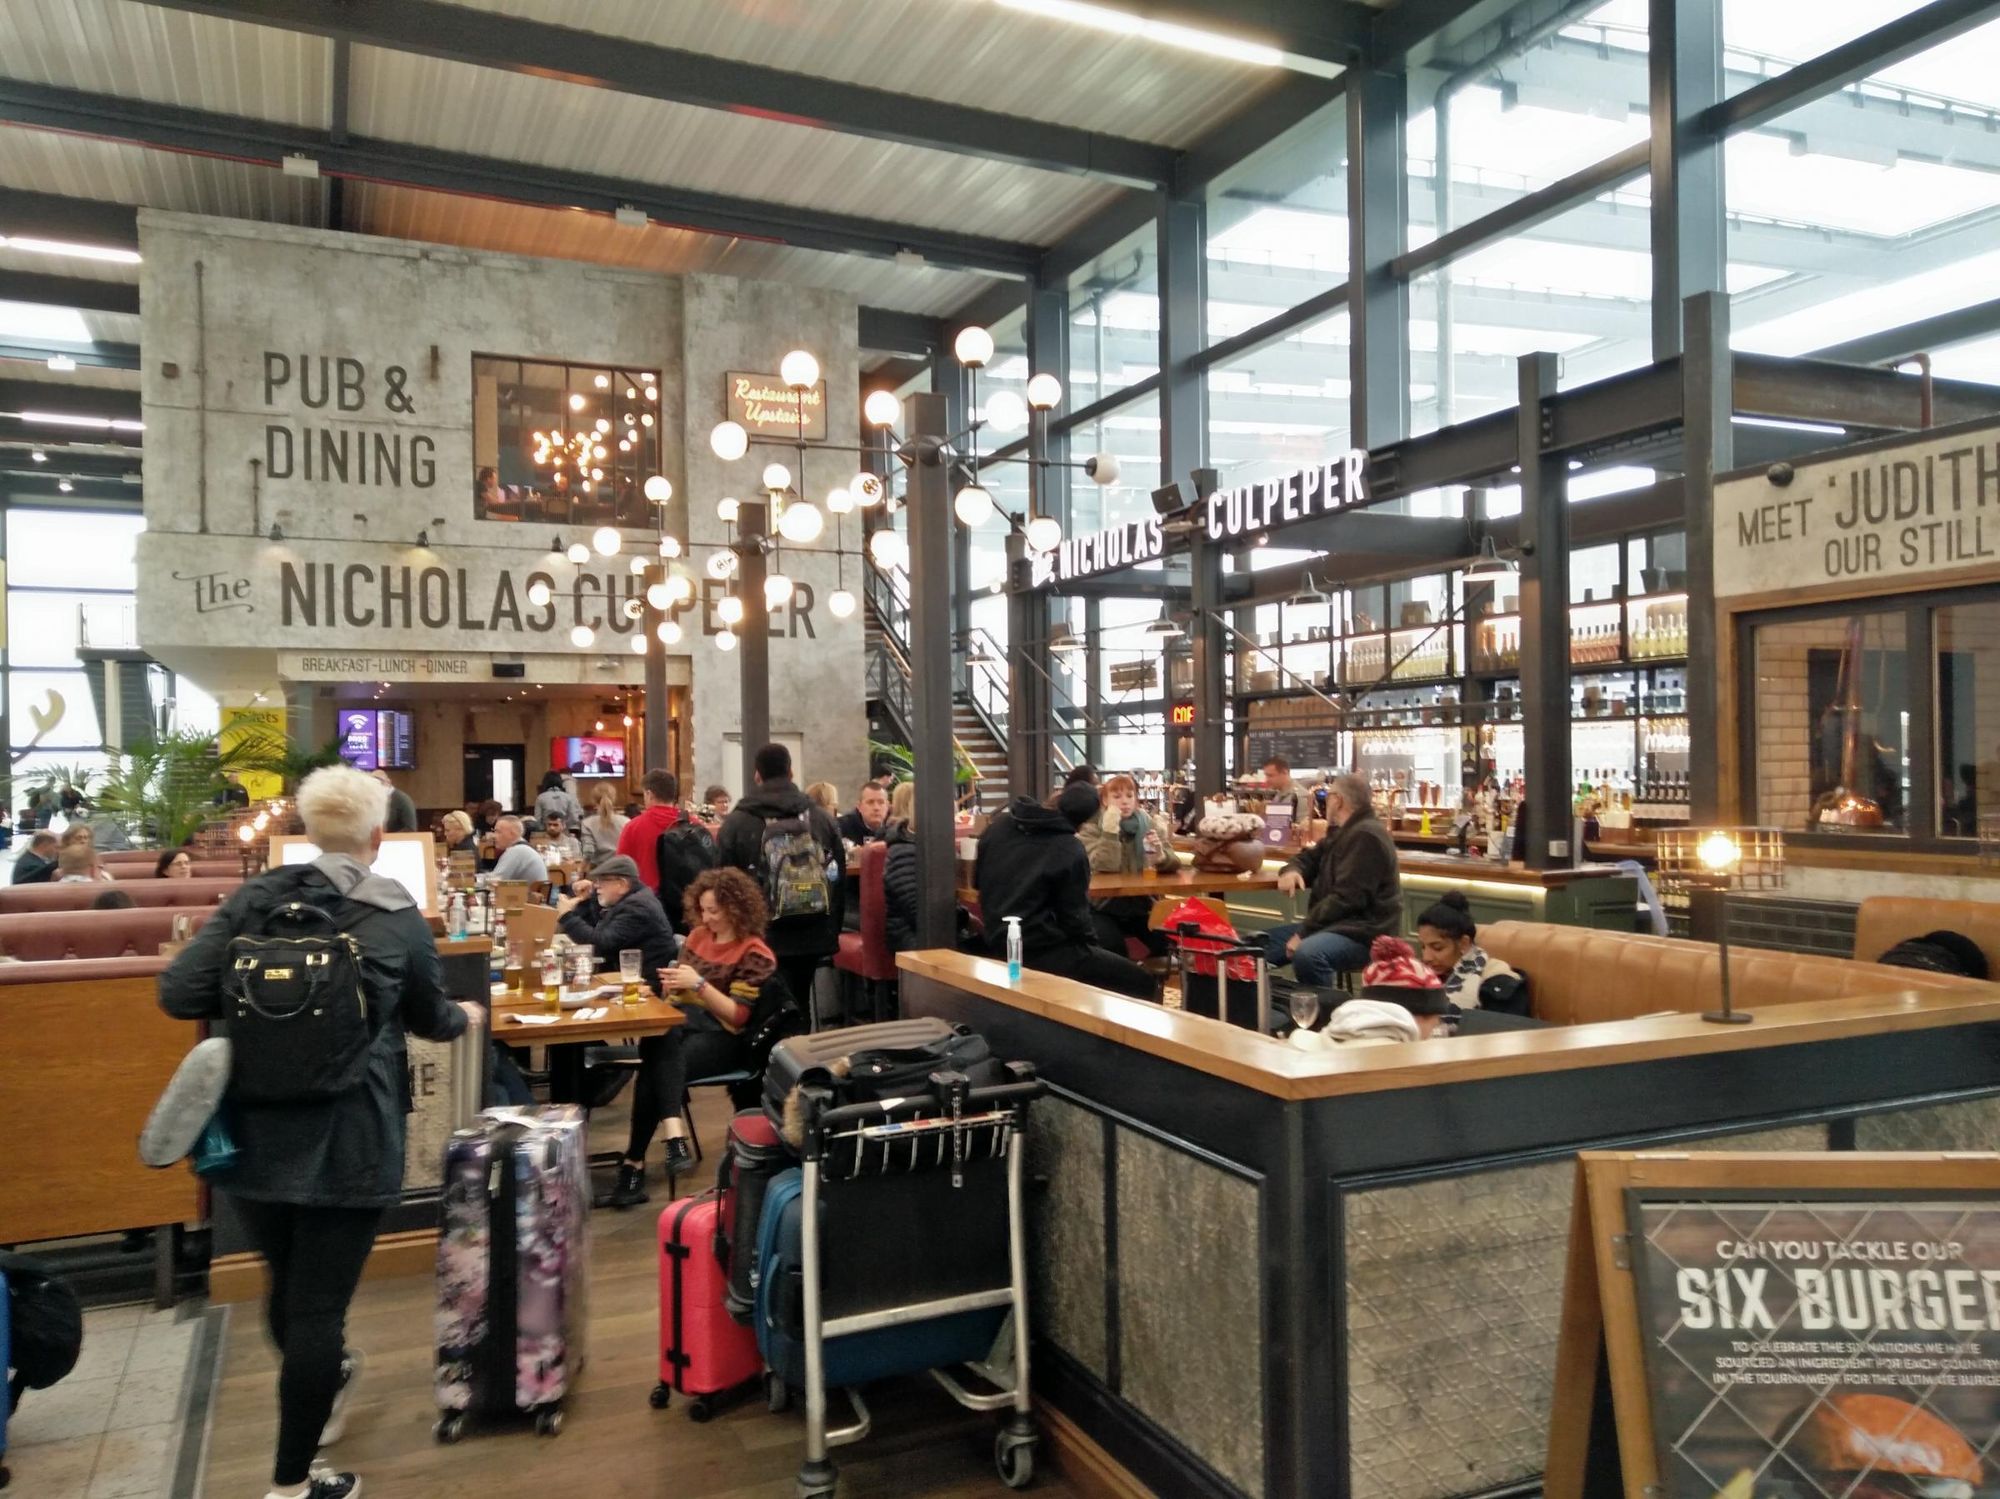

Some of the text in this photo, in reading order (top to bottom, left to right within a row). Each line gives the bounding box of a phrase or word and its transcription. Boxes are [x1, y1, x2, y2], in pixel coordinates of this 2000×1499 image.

[264, 351, 416, 414] PUB &
[745, 400, 811, 427] Upstais
[266, 425, 436, 488] DINING
[1059, 511, 1164, 580] NICHOLAS
[1207, 449, 1366, 540] CULPEPER
[1738, 498, 1813, 547] MEET
[1825, 516, 1994, 577] OUR STILL
[281, 561, 556, 633] NICHOLAS
[572, 573, 816, 640] CUPEER
[1716, 1240, 1964, 1260] CAN YOU TACKLE OUR
[1676, 1267, 1776, 1329] SIX
[1715, 1357, 1776, 1369] SOURCED
[1799, 1358, 1875, 1369] INGREDIENT
[1877, 1358, 1901, 1369] FOR
[1904, 1358, 1938, 1370] EACH
[1731, 1341, 1750, 1352] TO
[1752, 1341, 1819, 1352] CELEBRATE
[1820, 1342, 1846, 1353] THE
[1868, 1343, 1923, 1354] NATIONS
[1756, 1373, 1840, 1385] TOURNAMENT
[1843, 1374, 1869, 1385] FOR
[1872, 1374, 1898, 1385] THE
